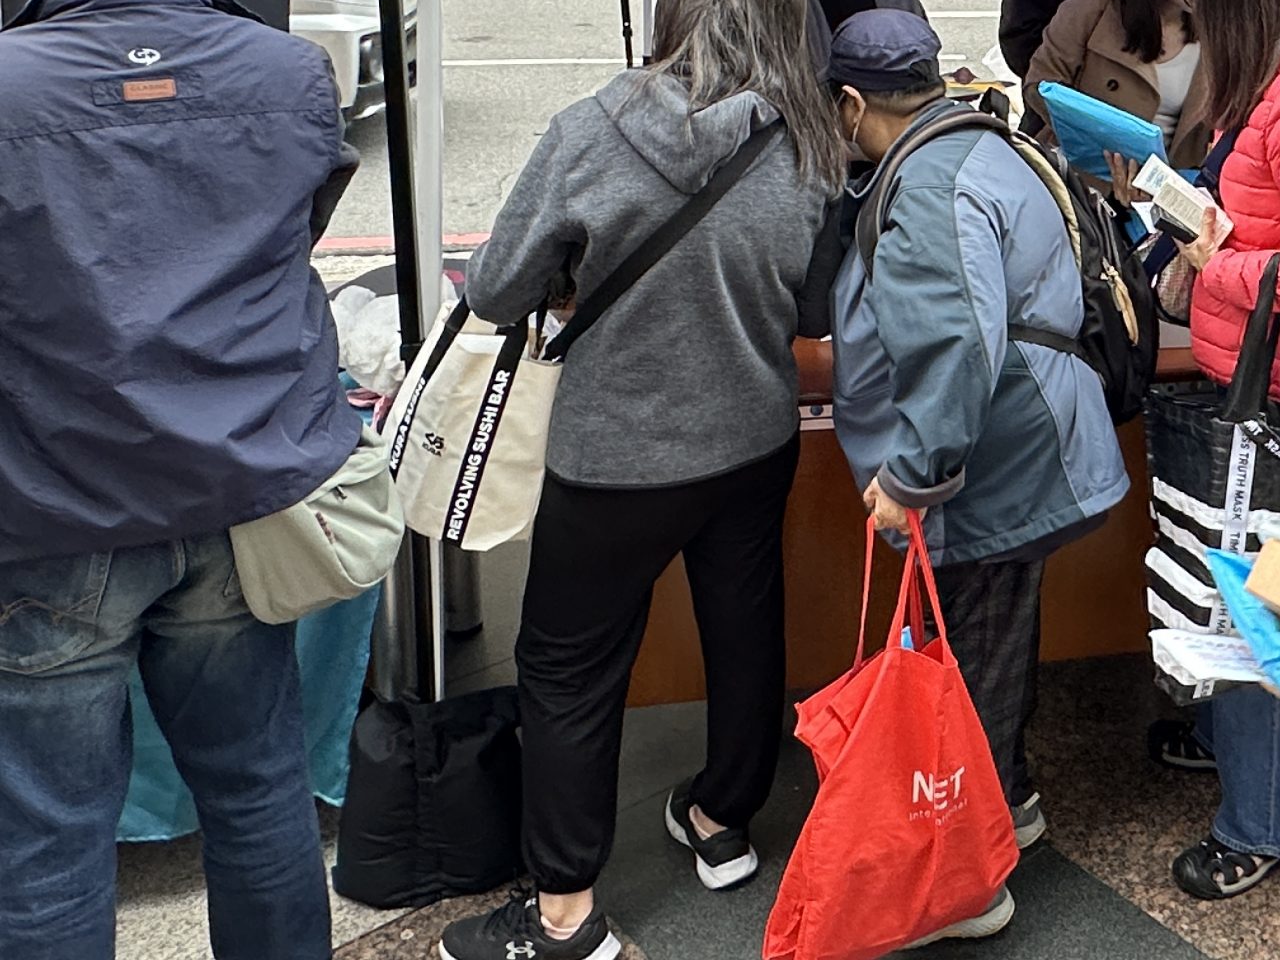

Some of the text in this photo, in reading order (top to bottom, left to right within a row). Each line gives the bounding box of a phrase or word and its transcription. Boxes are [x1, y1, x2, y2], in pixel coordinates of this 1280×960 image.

[389, 424, 408, 470] KURA
[446, 370, 511, 540] REVOLVING SUSHI BAR
[1236, 452, 1250, 487] TRUTH
[1231, 490, 1245, 521] MASK
[912, 765, 966, 811] NET
